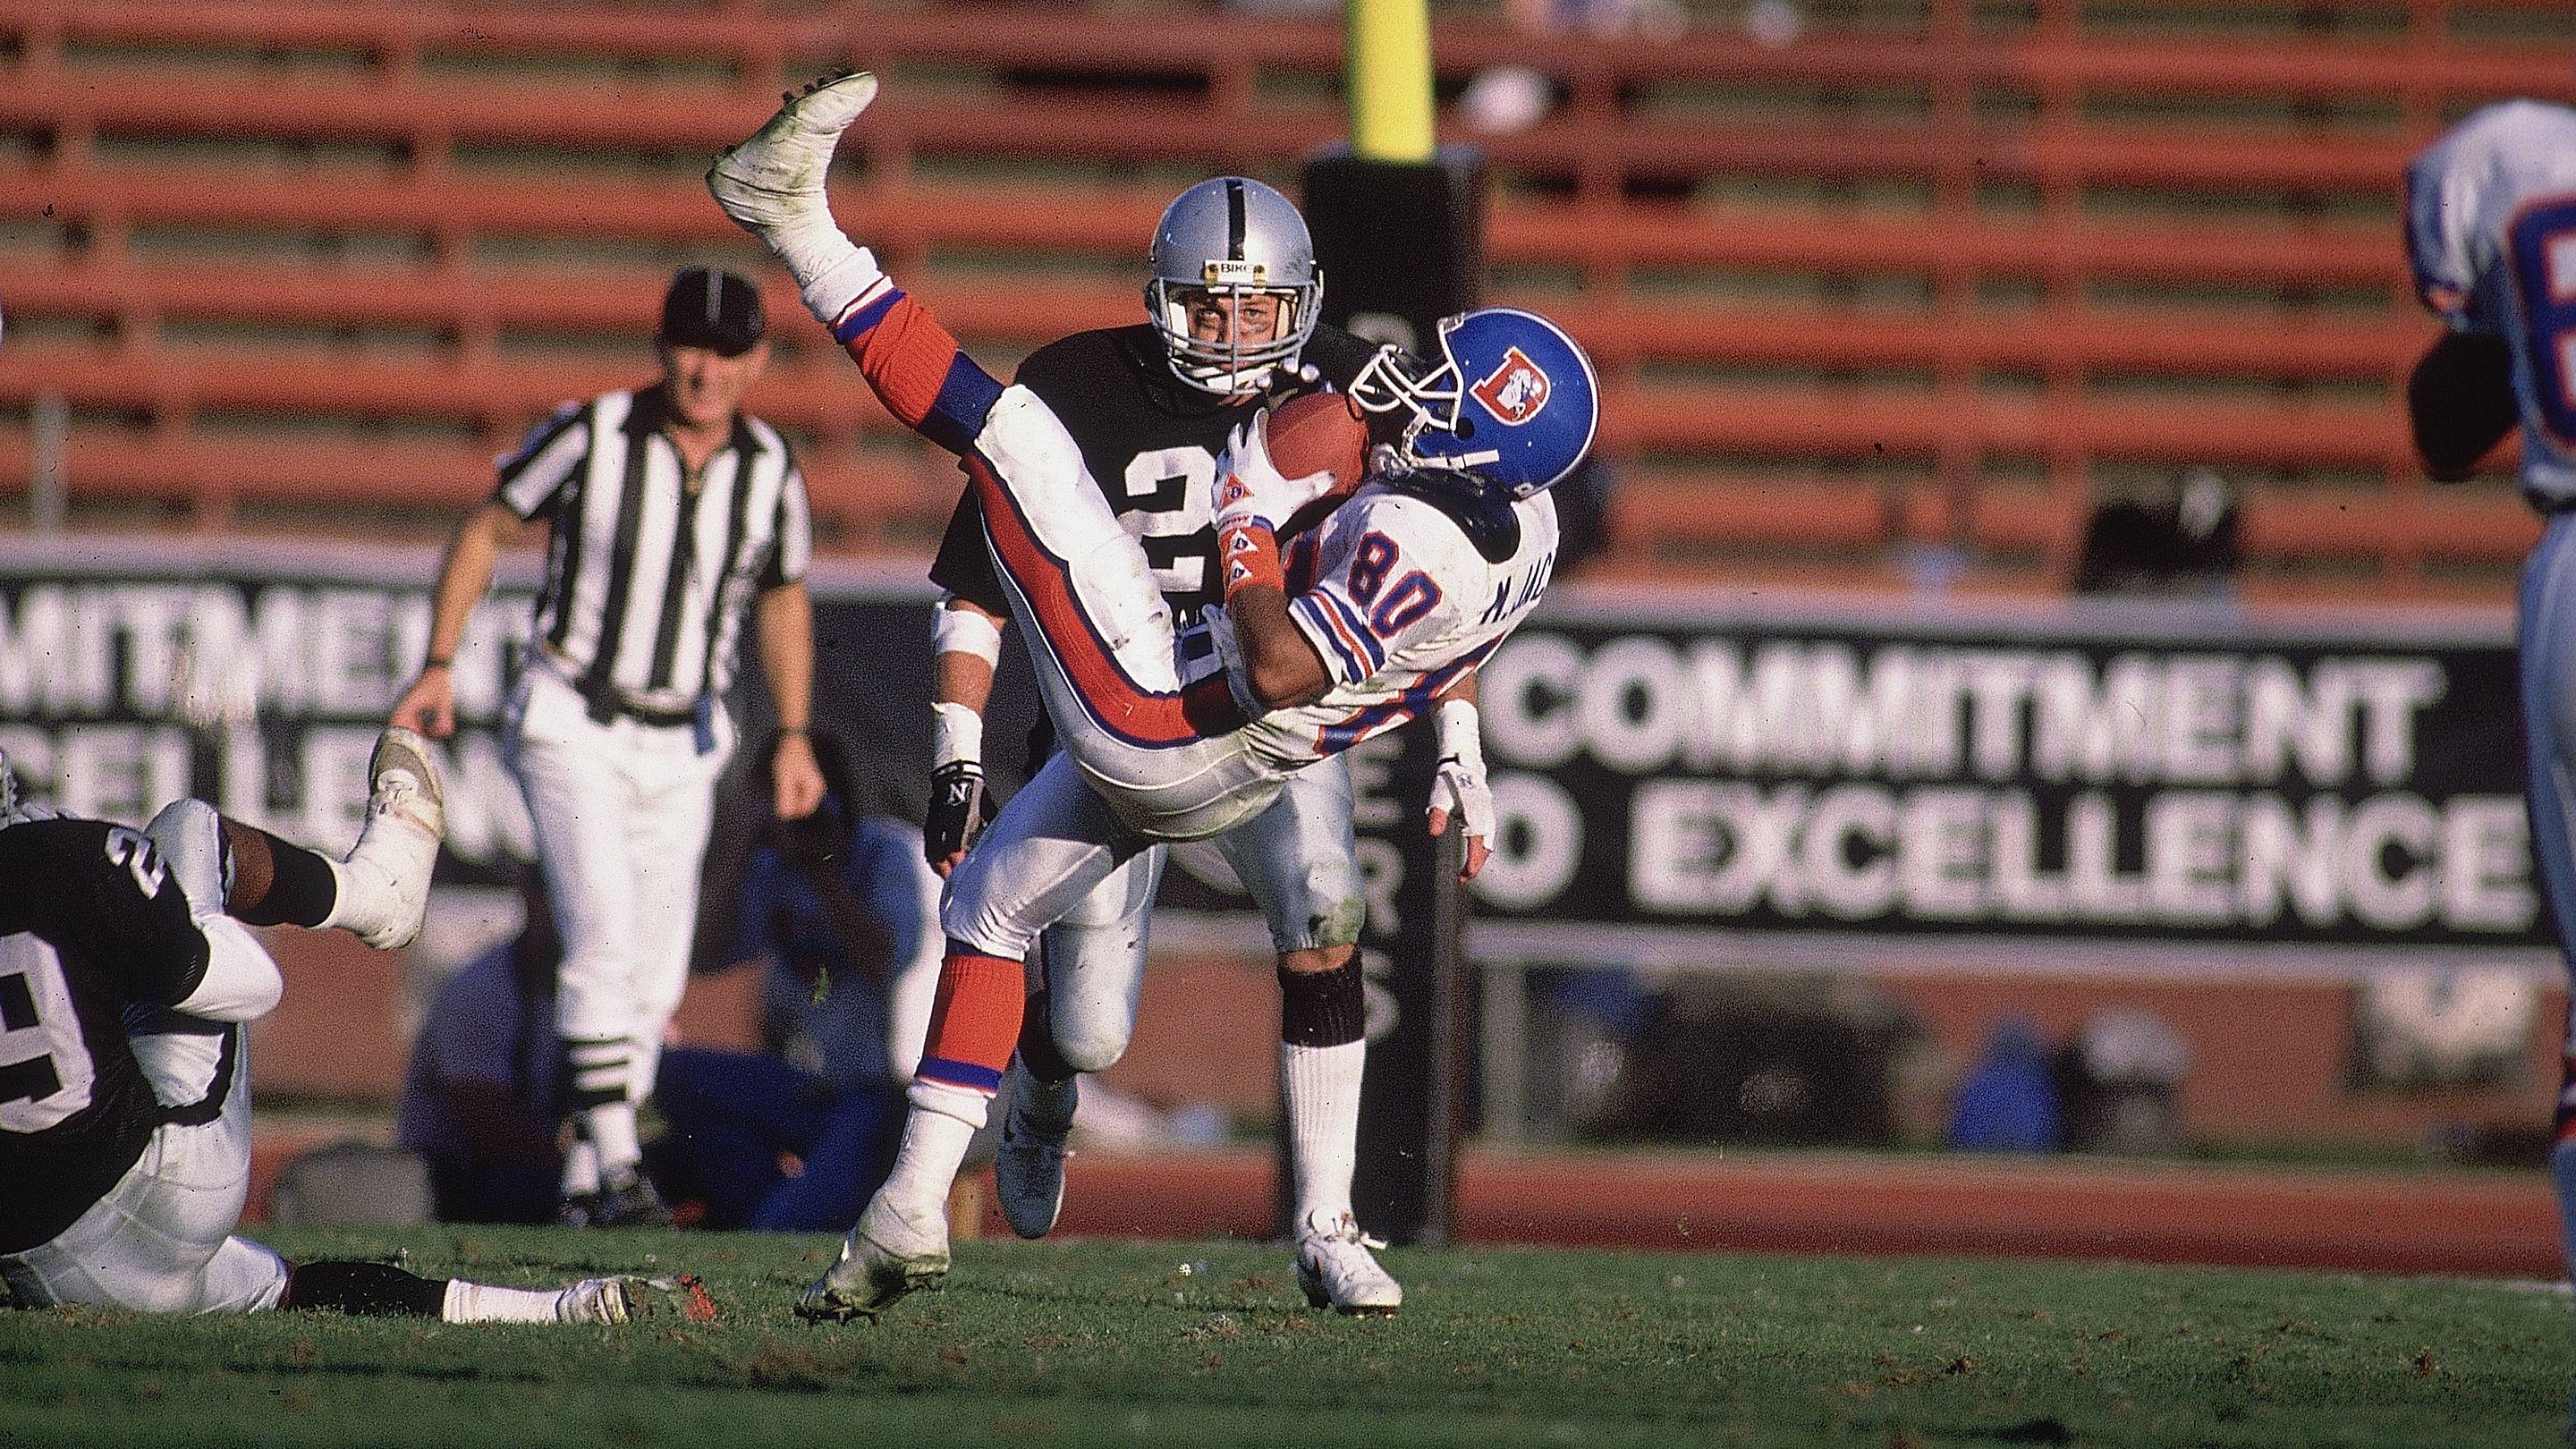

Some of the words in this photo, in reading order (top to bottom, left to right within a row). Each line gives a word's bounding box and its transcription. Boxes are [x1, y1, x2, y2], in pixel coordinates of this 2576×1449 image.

[1118, 445, 1217, 592] 2
[1347, 530, 1443, 640] 80
[1476, 631, 2449, 784] COMMITMENT
[1469, 771, 1583, 911] O
[1626, 776, 2543, 932] EXCELLENCE
